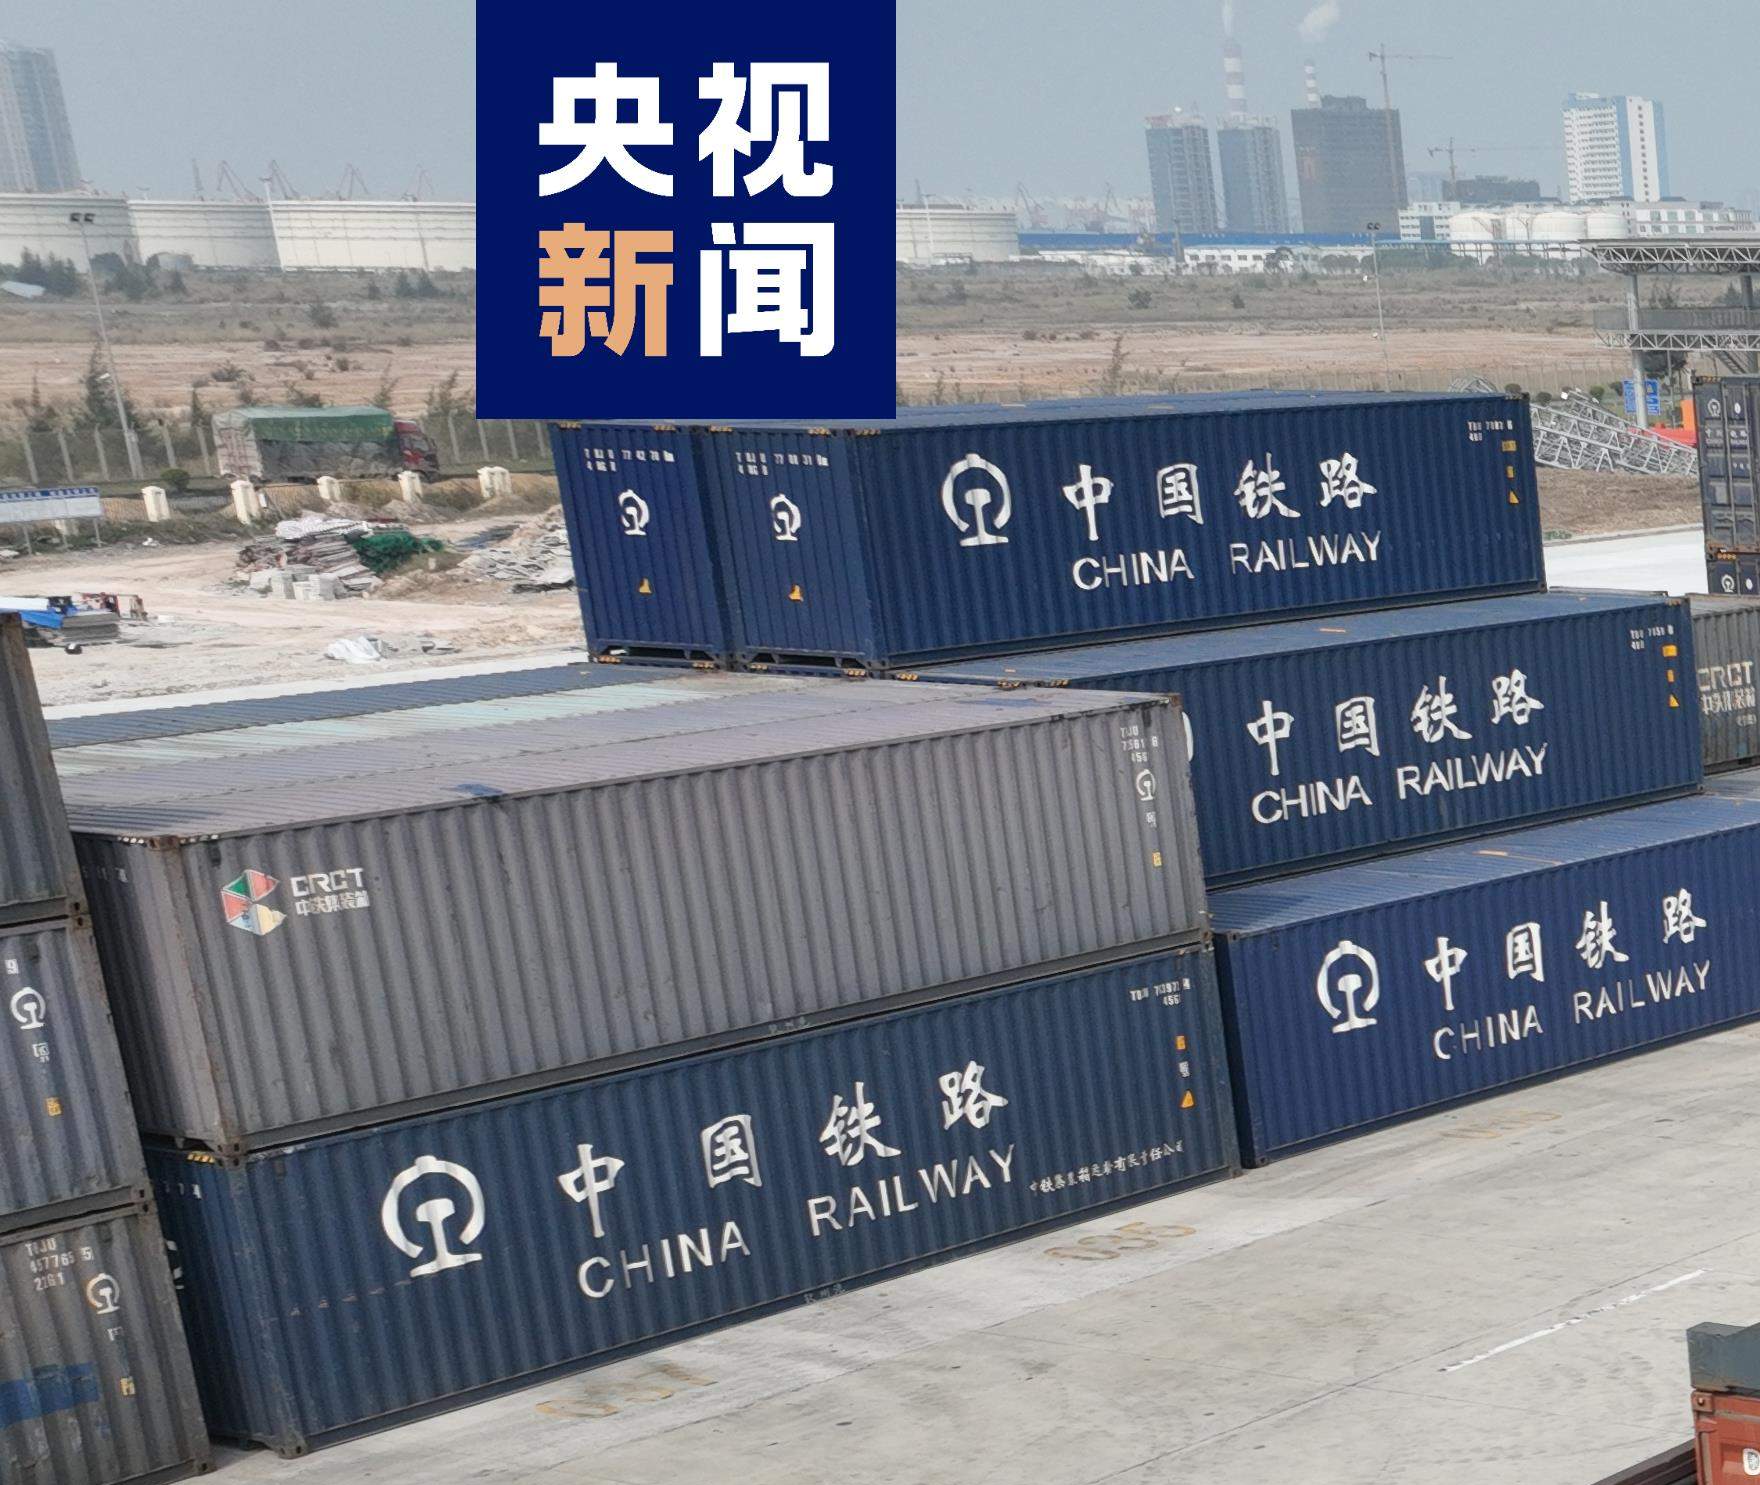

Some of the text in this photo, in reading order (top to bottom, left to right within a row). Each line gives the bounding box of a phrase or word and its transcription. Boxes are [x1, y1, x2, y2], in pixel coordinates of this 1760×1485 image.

[1063, 452, 1377, 540] 中国铁路
[1072, 530, 1381, 590] CHINA RAILWAY
[1247, 669, 1544, 775] 中国铁路
[1251, 742, 1548, 825] CHINA RAILWAY
[291, 868, 364, 897] CRCT
[1424, 888, 1707, 1011] 中国铁路
[1433, 960, 1711, 1061] CHINA RAILWAY
[557, 1060, 1009, 1238] 中国铁路
[578, 1143, 1016, 1299] CHINA RAILWAY
